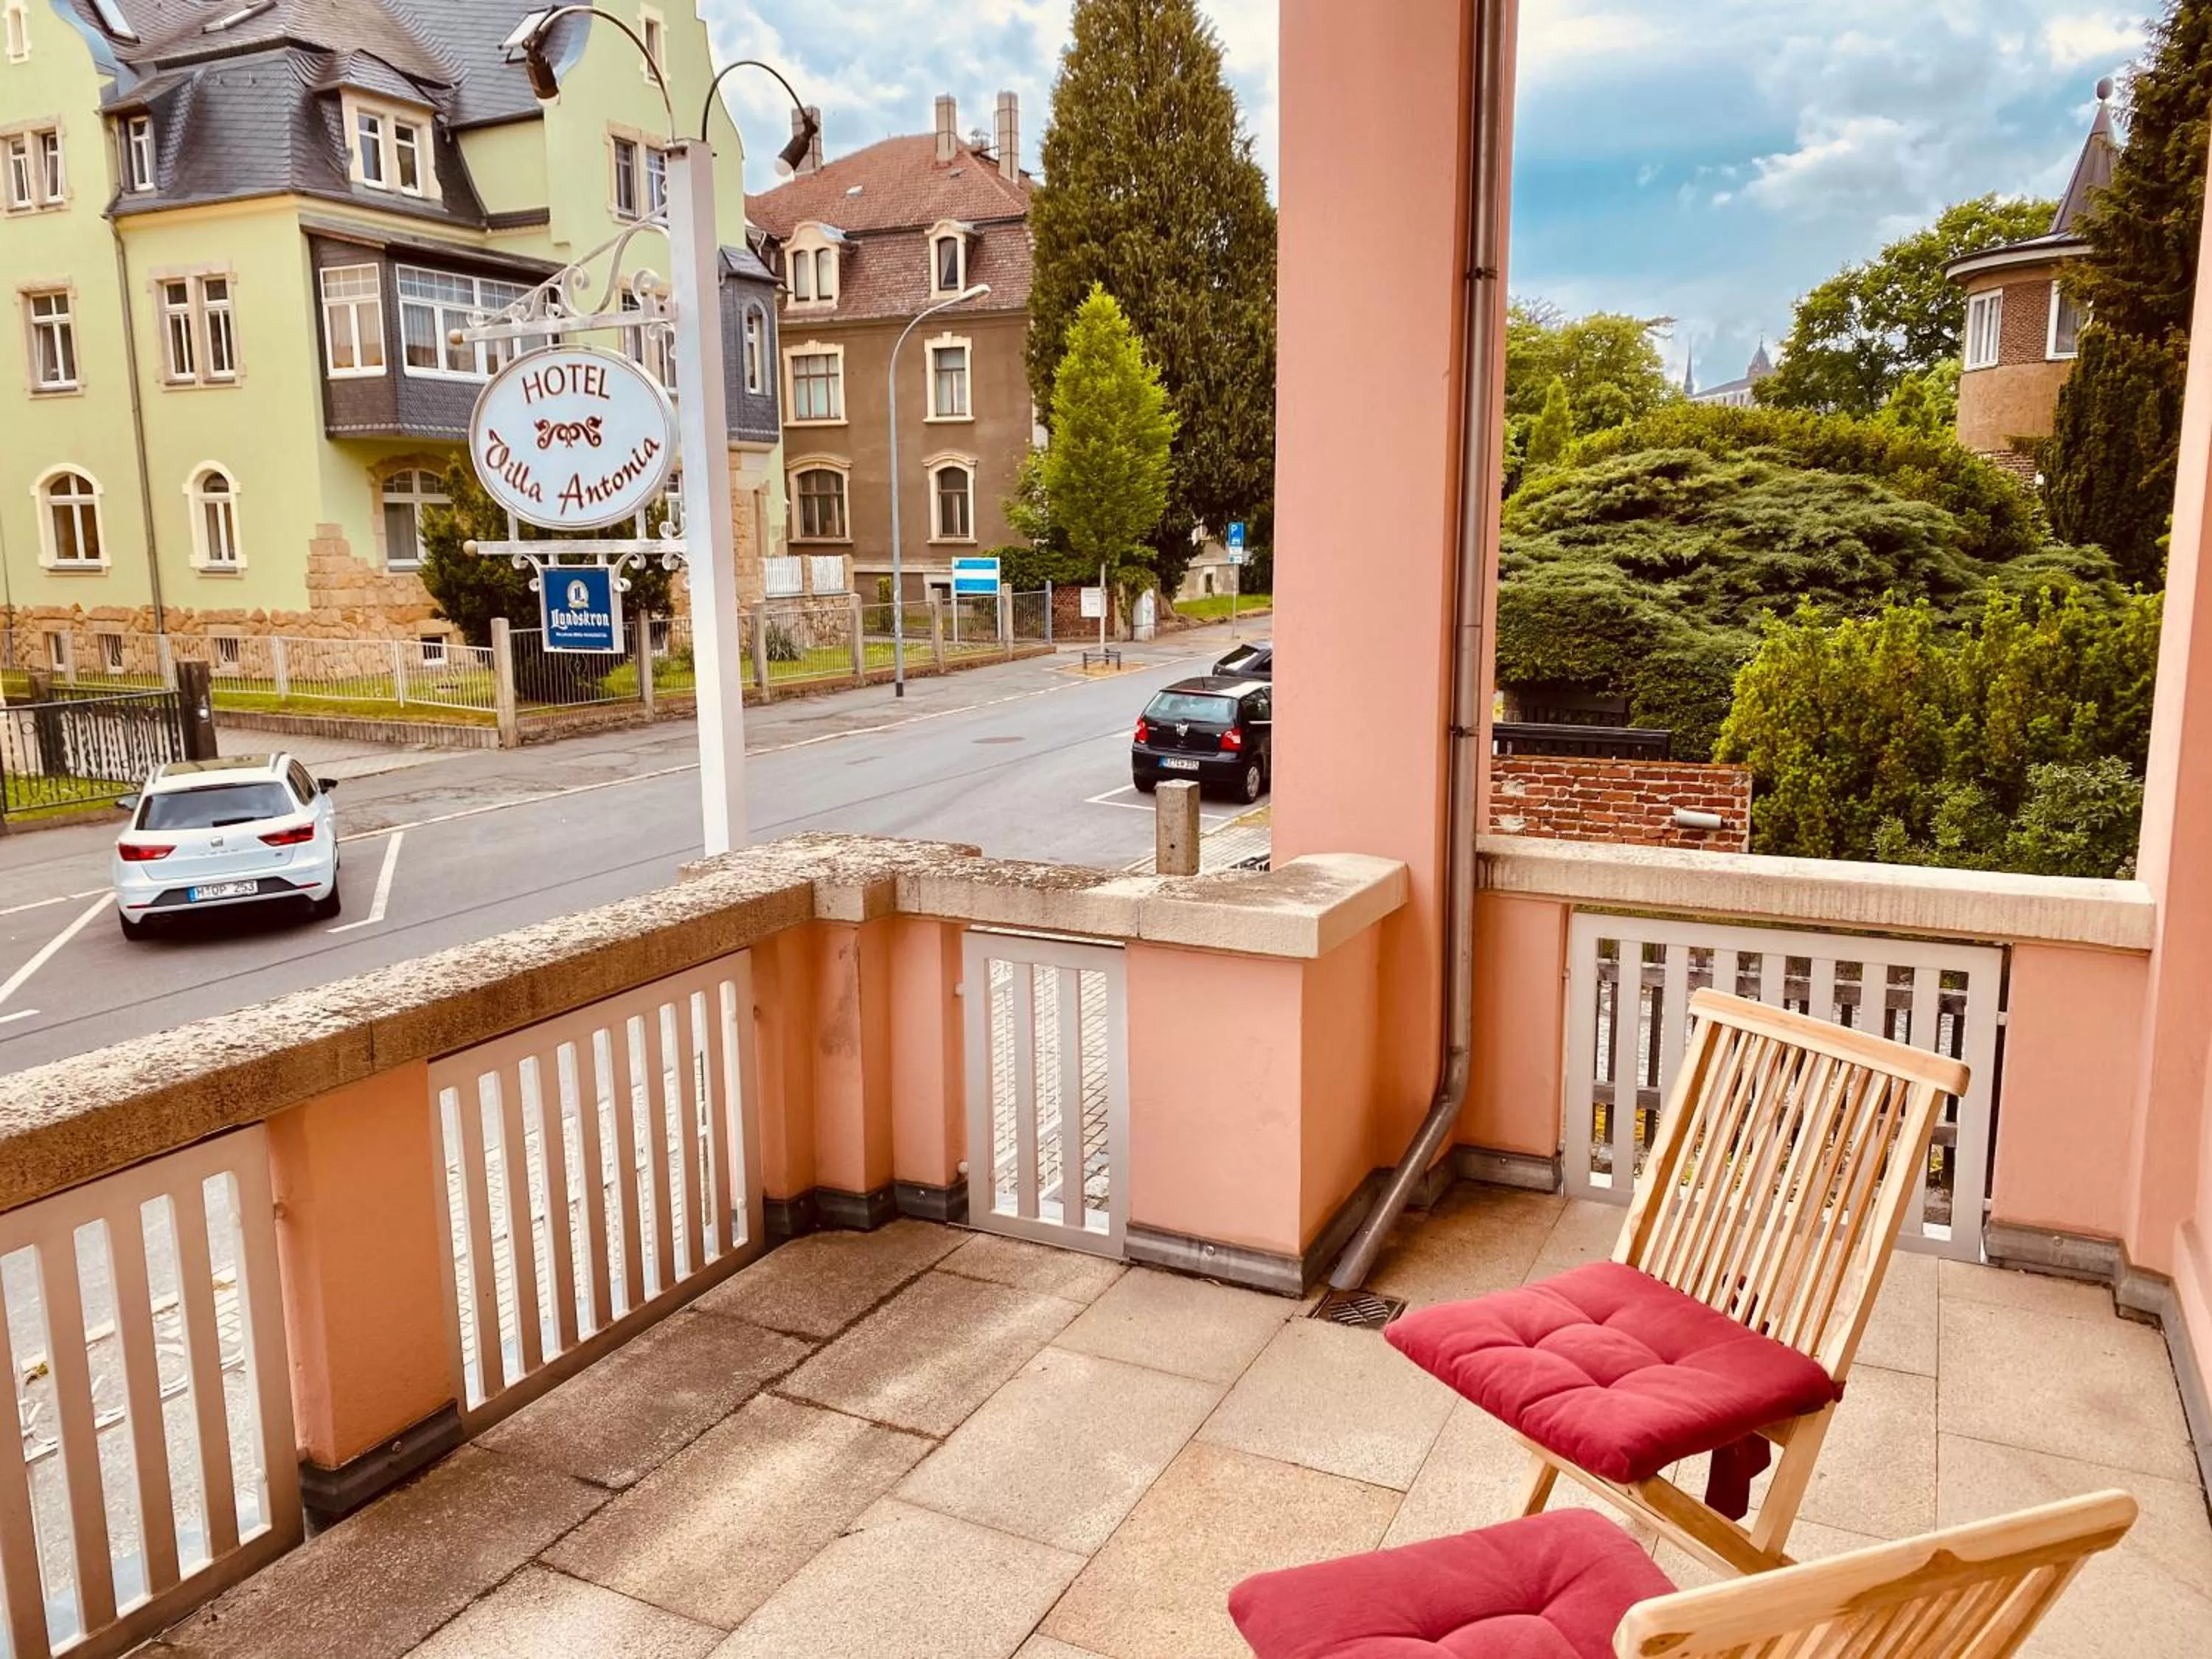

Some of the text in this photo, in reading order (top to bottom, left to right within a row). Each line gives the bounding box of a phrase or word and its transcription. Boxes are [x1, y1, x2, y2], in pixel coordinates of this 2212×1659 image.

[521, 364, 611, 404] HOTEL
[486, 428, 661, 516] Villa Antonia
[1231, 524, 1238, 535] P
[550, 609, 610, 630] Landskron
